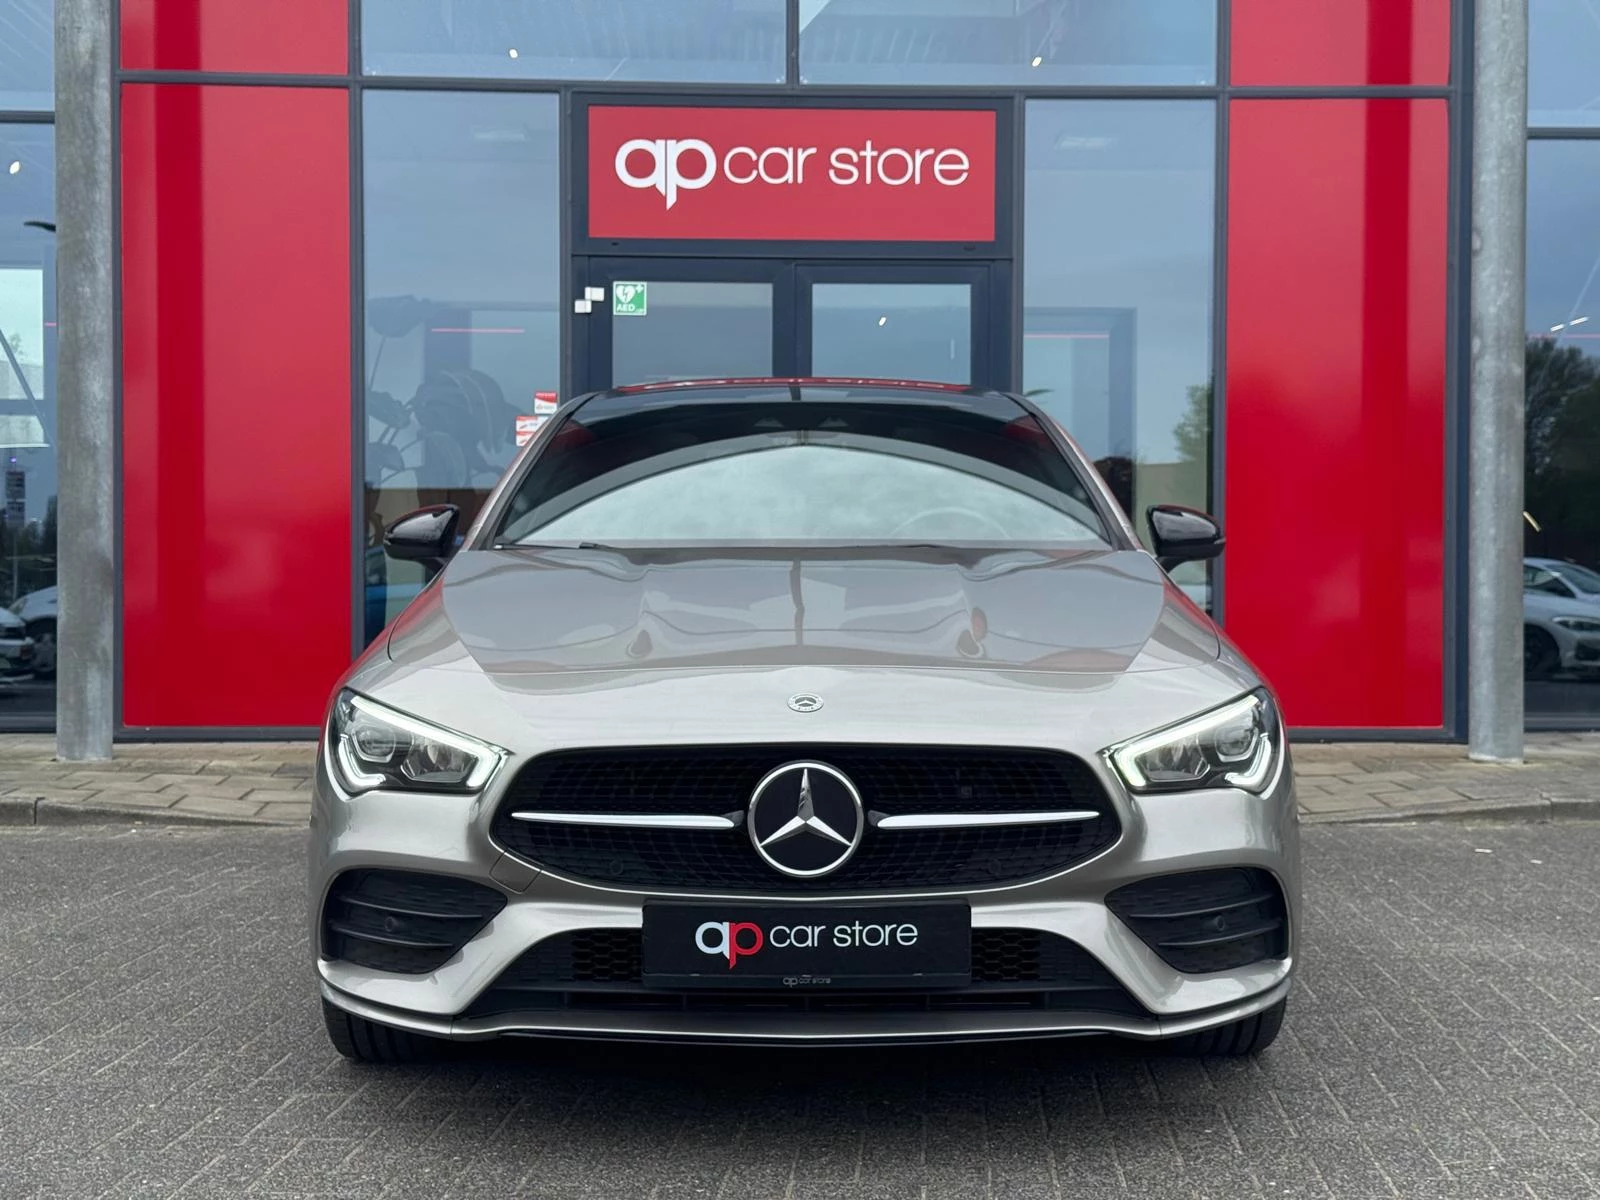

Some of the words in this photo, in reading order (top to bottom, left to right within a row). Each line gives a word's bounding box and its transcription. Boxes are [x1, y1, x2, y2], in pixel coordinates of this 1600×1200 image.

[614, 138, 717, 210] ap
[723, 146, 818, 185] car
[828, 139, 970, 186] store
[616, 303, 636, 312] AED
[694, 921, 764, 969] ap
[769, 925, 827, 948] car
[832, 920, 919, 947] store
